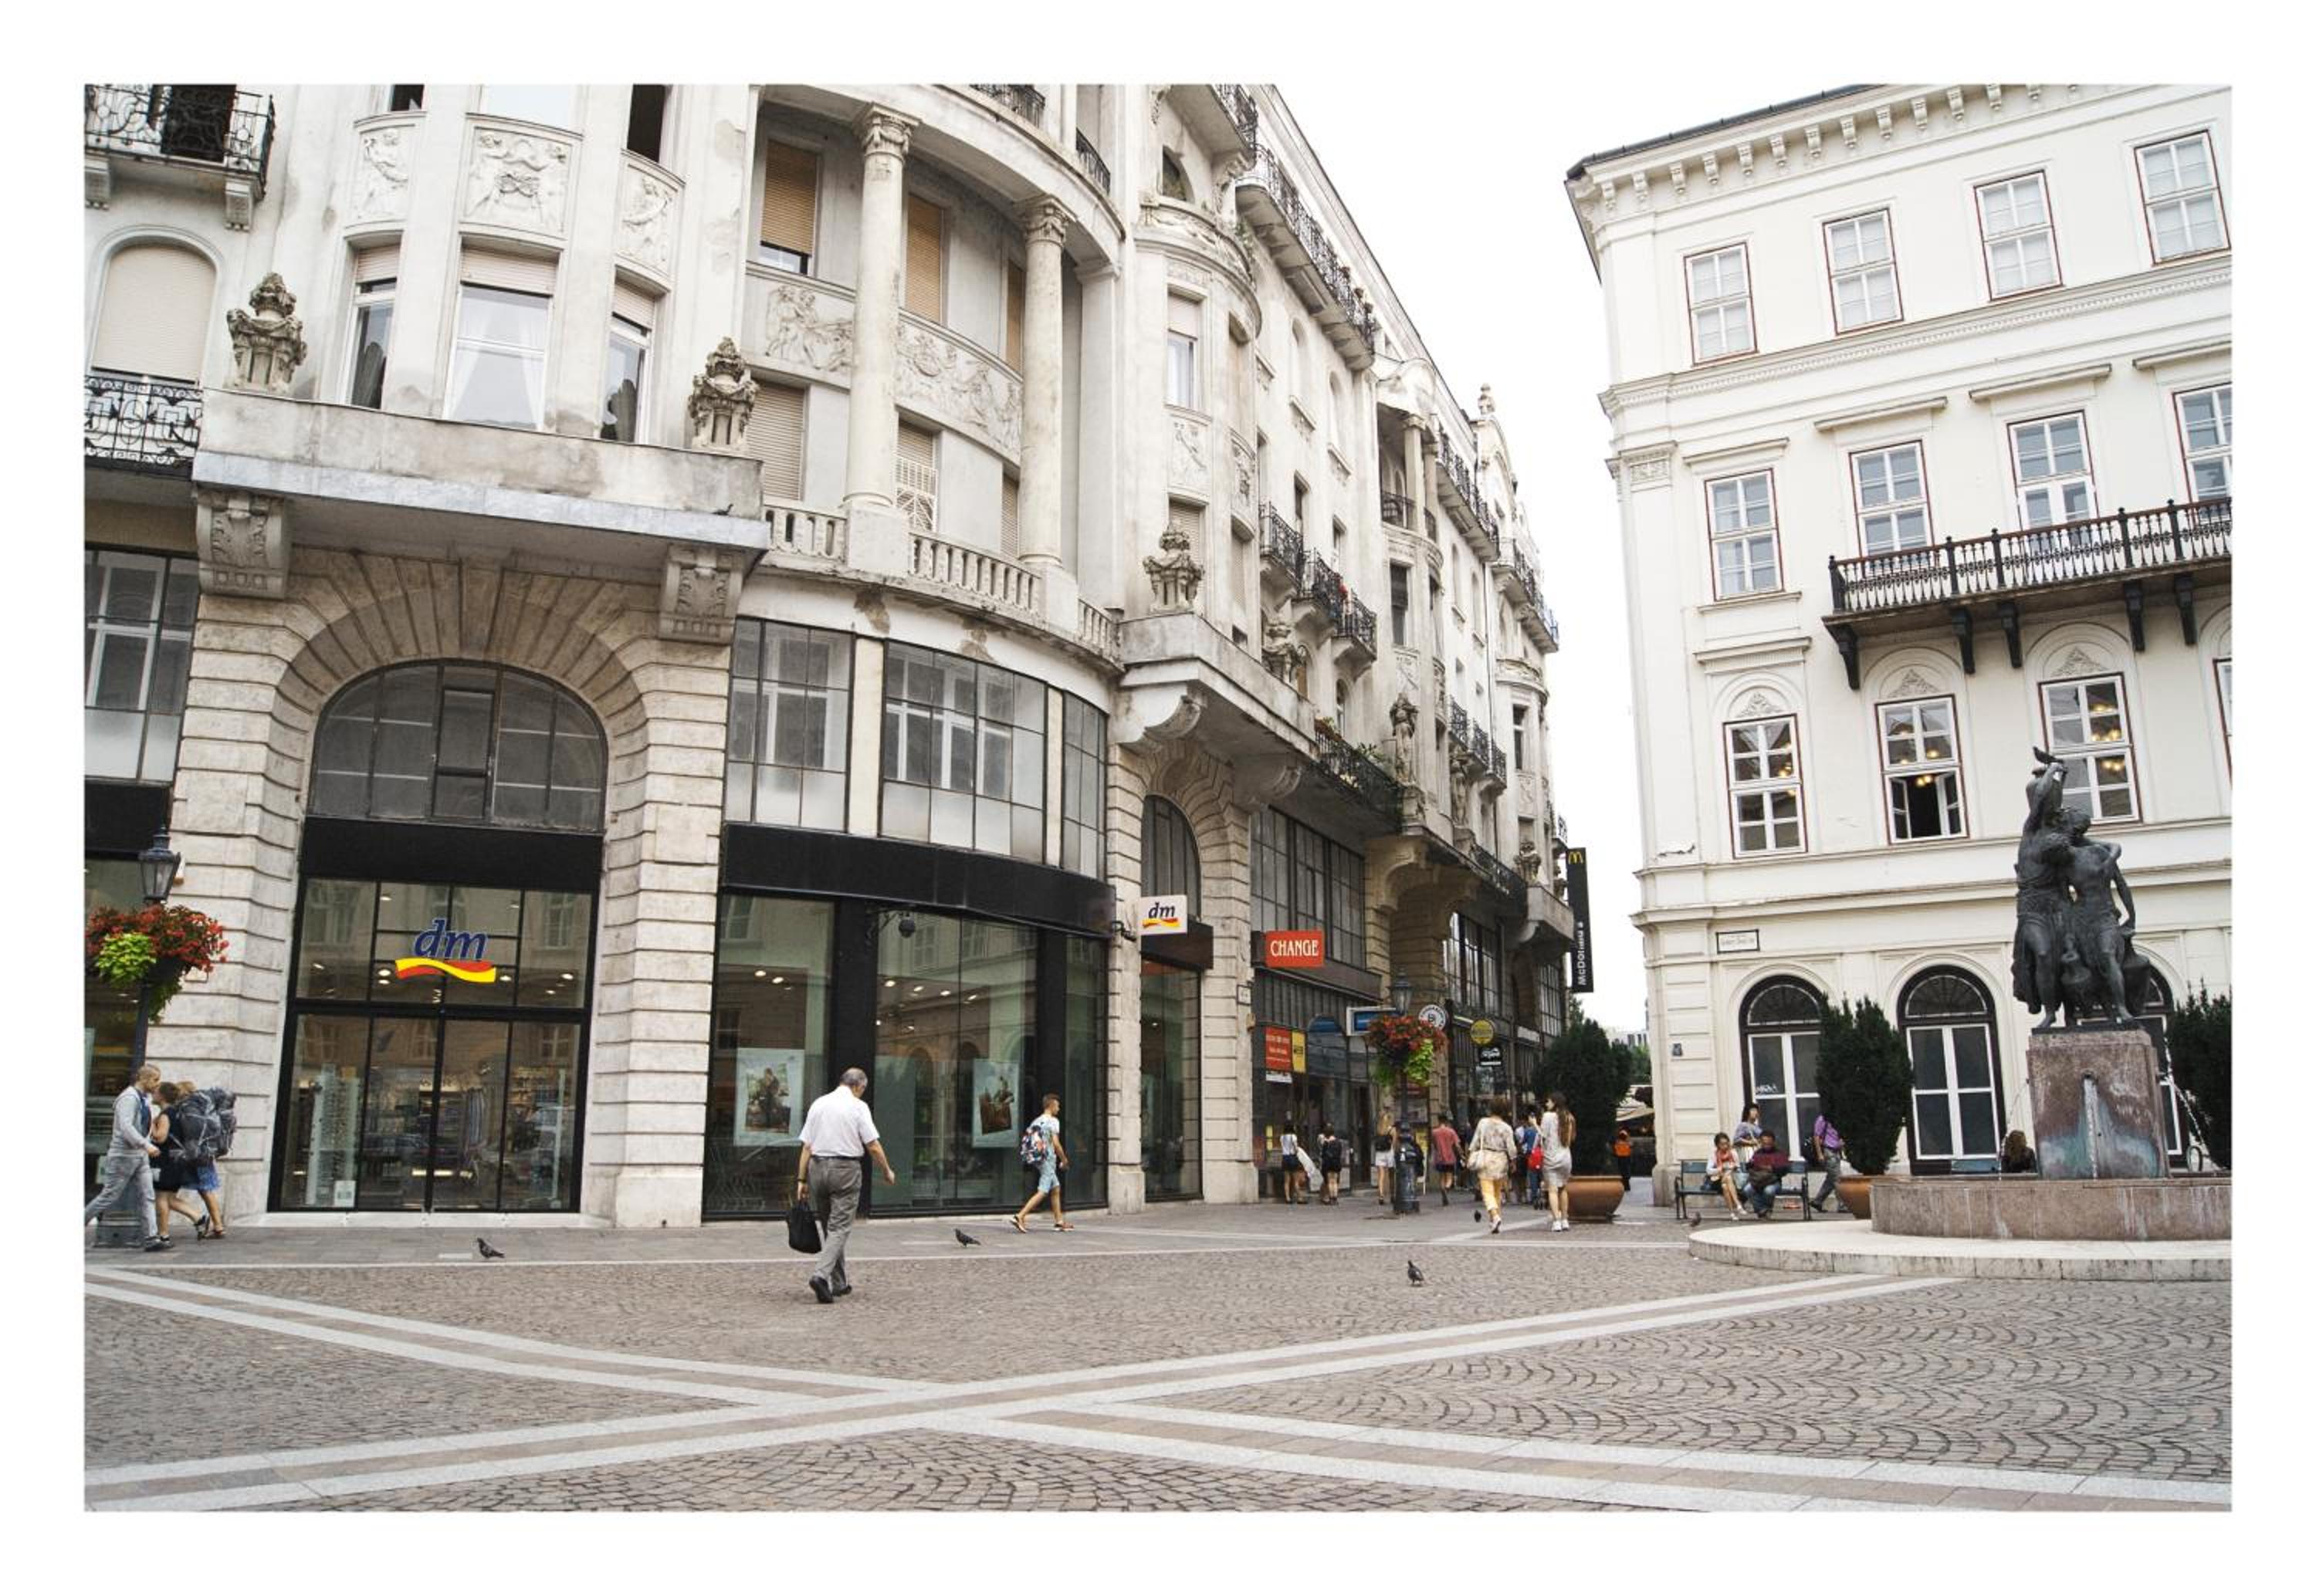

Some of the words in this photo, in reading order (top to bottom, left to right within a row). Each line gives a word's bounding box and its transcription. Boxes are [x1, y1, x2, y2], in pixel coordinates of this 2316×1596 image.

[1149, 901, 1175, 918] dm
[414, 918, 487, 960] dm
[1270, 938, 1319, 957] CHANGE
[1577, 921, 1586, 986] McDonlds
